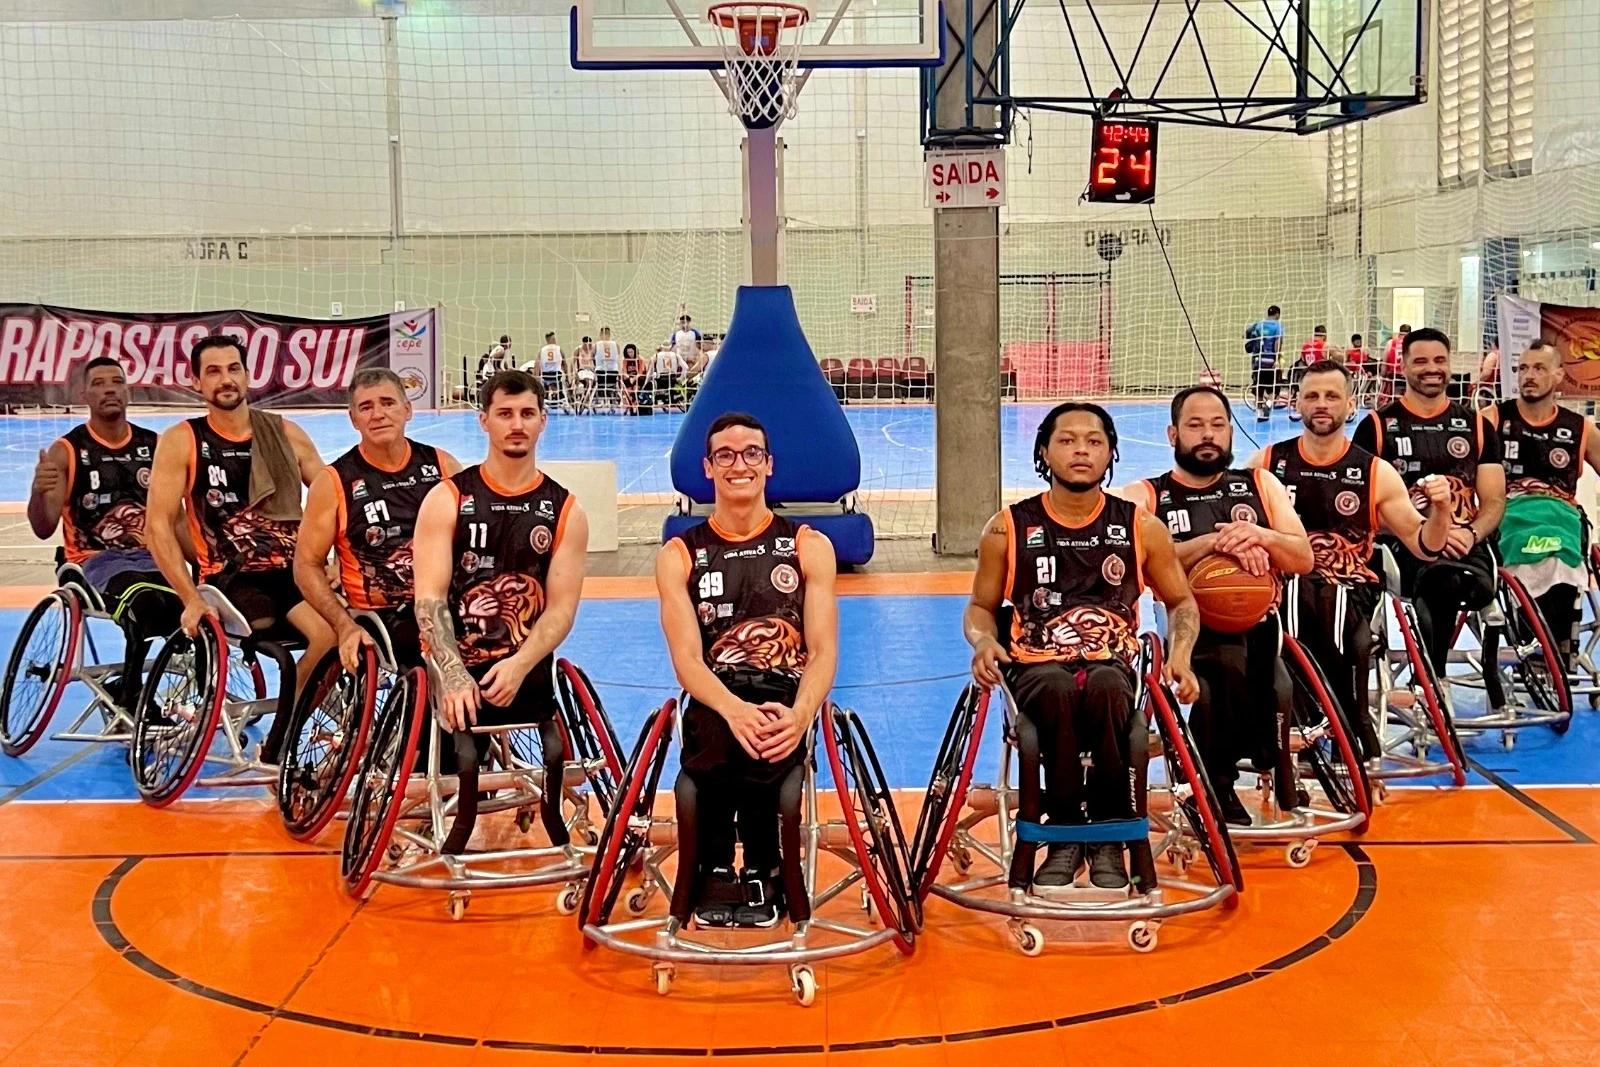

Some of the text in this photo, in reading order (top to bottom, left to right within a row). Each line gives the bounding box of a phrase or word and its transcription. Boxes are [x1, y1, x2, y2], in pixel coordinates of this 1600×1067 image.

[1103, 125, 1149, 142] 42:44
[1394, 436, 1413, 456] 10
[1504, 440, 1519, 459] 12
[89, 471, 100, 490] 8
[207, 465, 228, 487] 84
[364, 500, 390, 524] 27
[1167, 509, 1191, 535] 20
[468, 523, 488, 548] 11
[723, 551, 738, 560] VIDA
[1035, 555, 1057, 584] 21
[698, 571, 724, 599] 99
